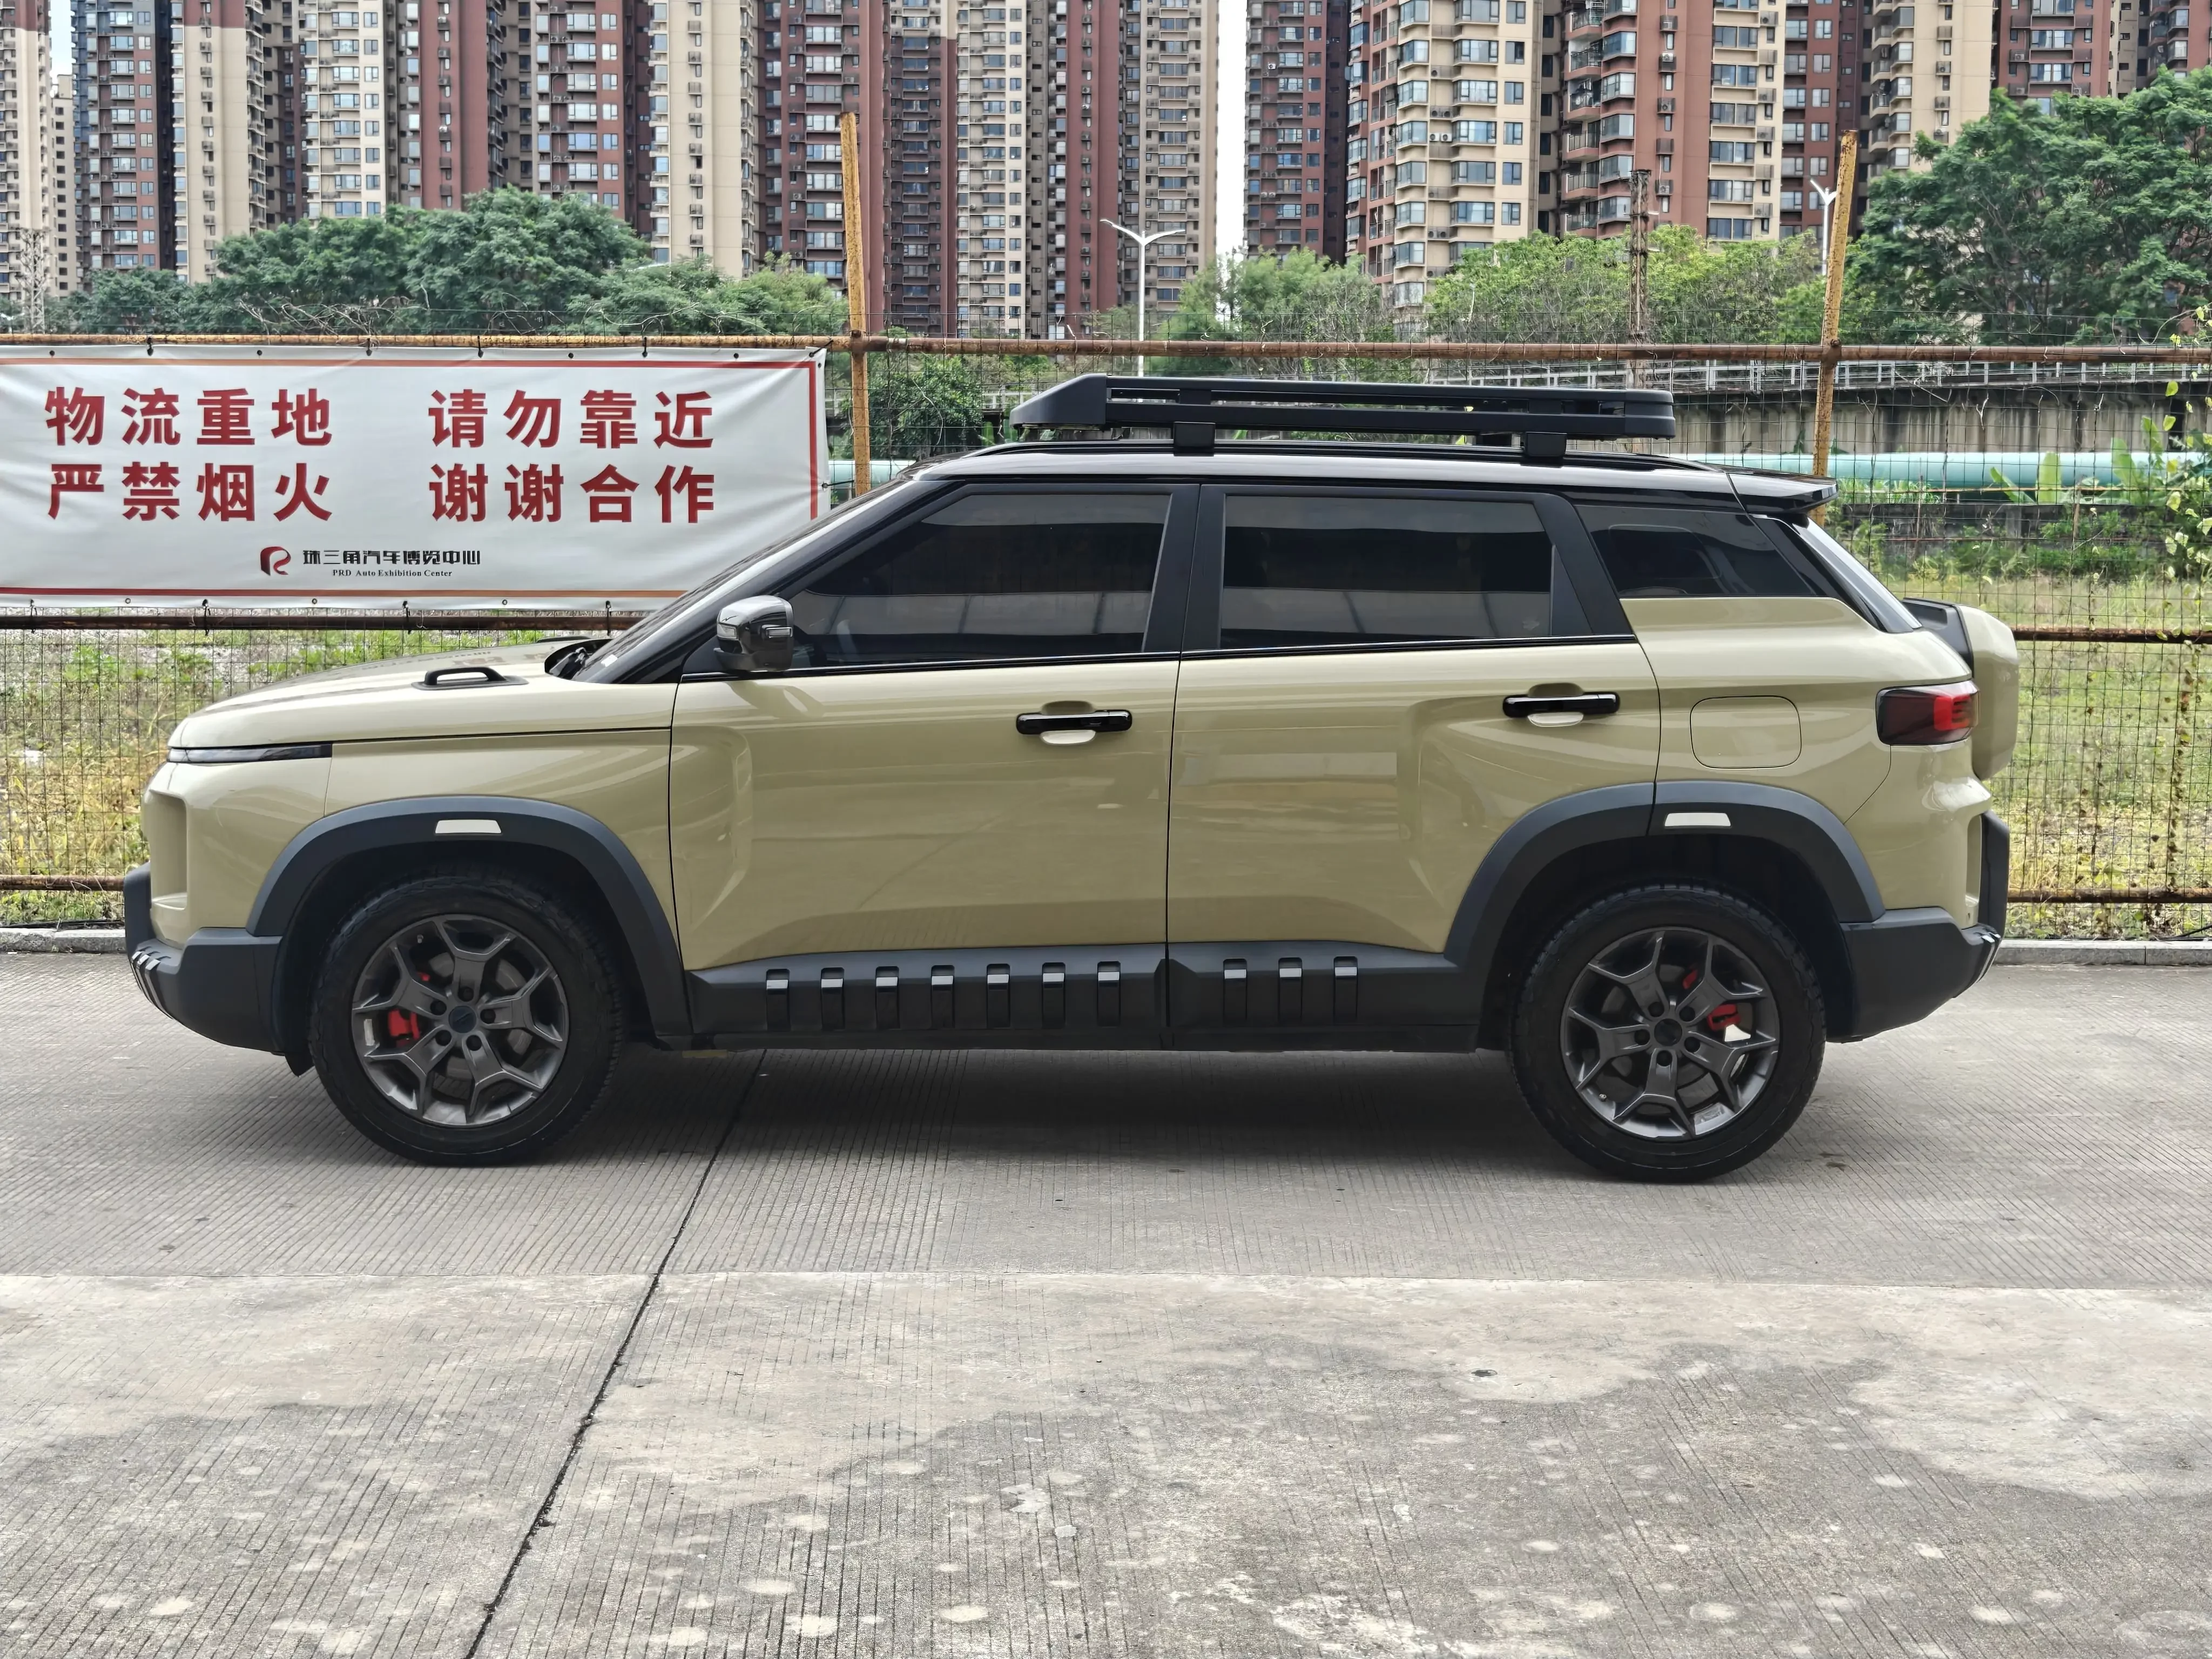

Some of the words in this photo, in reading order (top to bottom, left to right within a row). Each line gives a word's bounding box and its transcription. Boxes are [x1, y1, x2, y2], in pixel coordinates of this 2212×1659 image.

[45, 387, 332, 446] 物流重地
[429, 388, 713, 449] 请勿靠近
[49, 462, 332, 521] 严禁烟火
[429, 463, 714, 524] 谢谢合作
[302, 549, 481, 565] 珠三角汽车博览中心
[333, 569, 352, 577] PRD
[355, 569, 376, 577] Auto
[378, 569, 422, 577] Exhibition
[424, 569, 453, 577] Center
